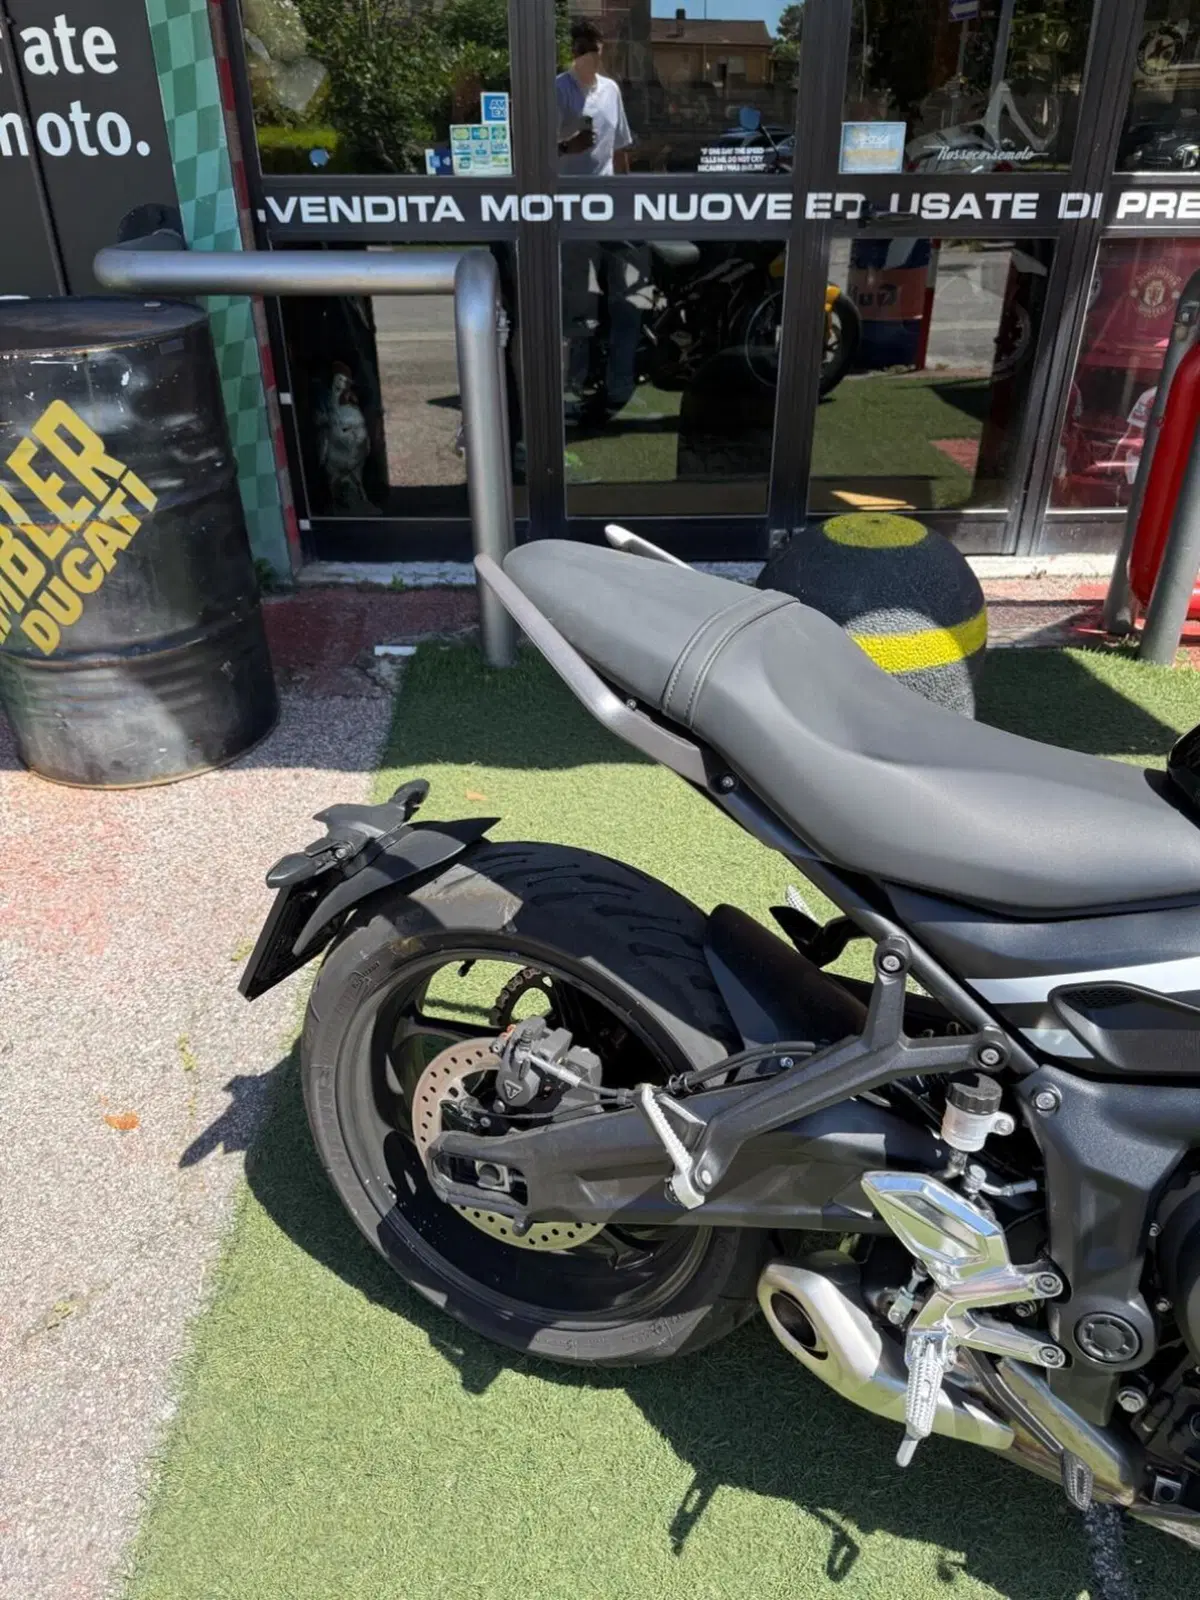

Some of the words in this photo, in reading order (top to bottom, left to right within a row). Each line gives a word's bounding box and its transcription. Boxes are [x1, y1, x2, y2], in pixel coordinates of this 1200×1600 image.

[0, 14, 118, 75] ate
[480, 193, 614, 223] MOTO
[633, 192, 793, 221] NUOVE
[1057, 191, 1103, 219] DI
[20, 469, 158, 656] DUCATI
